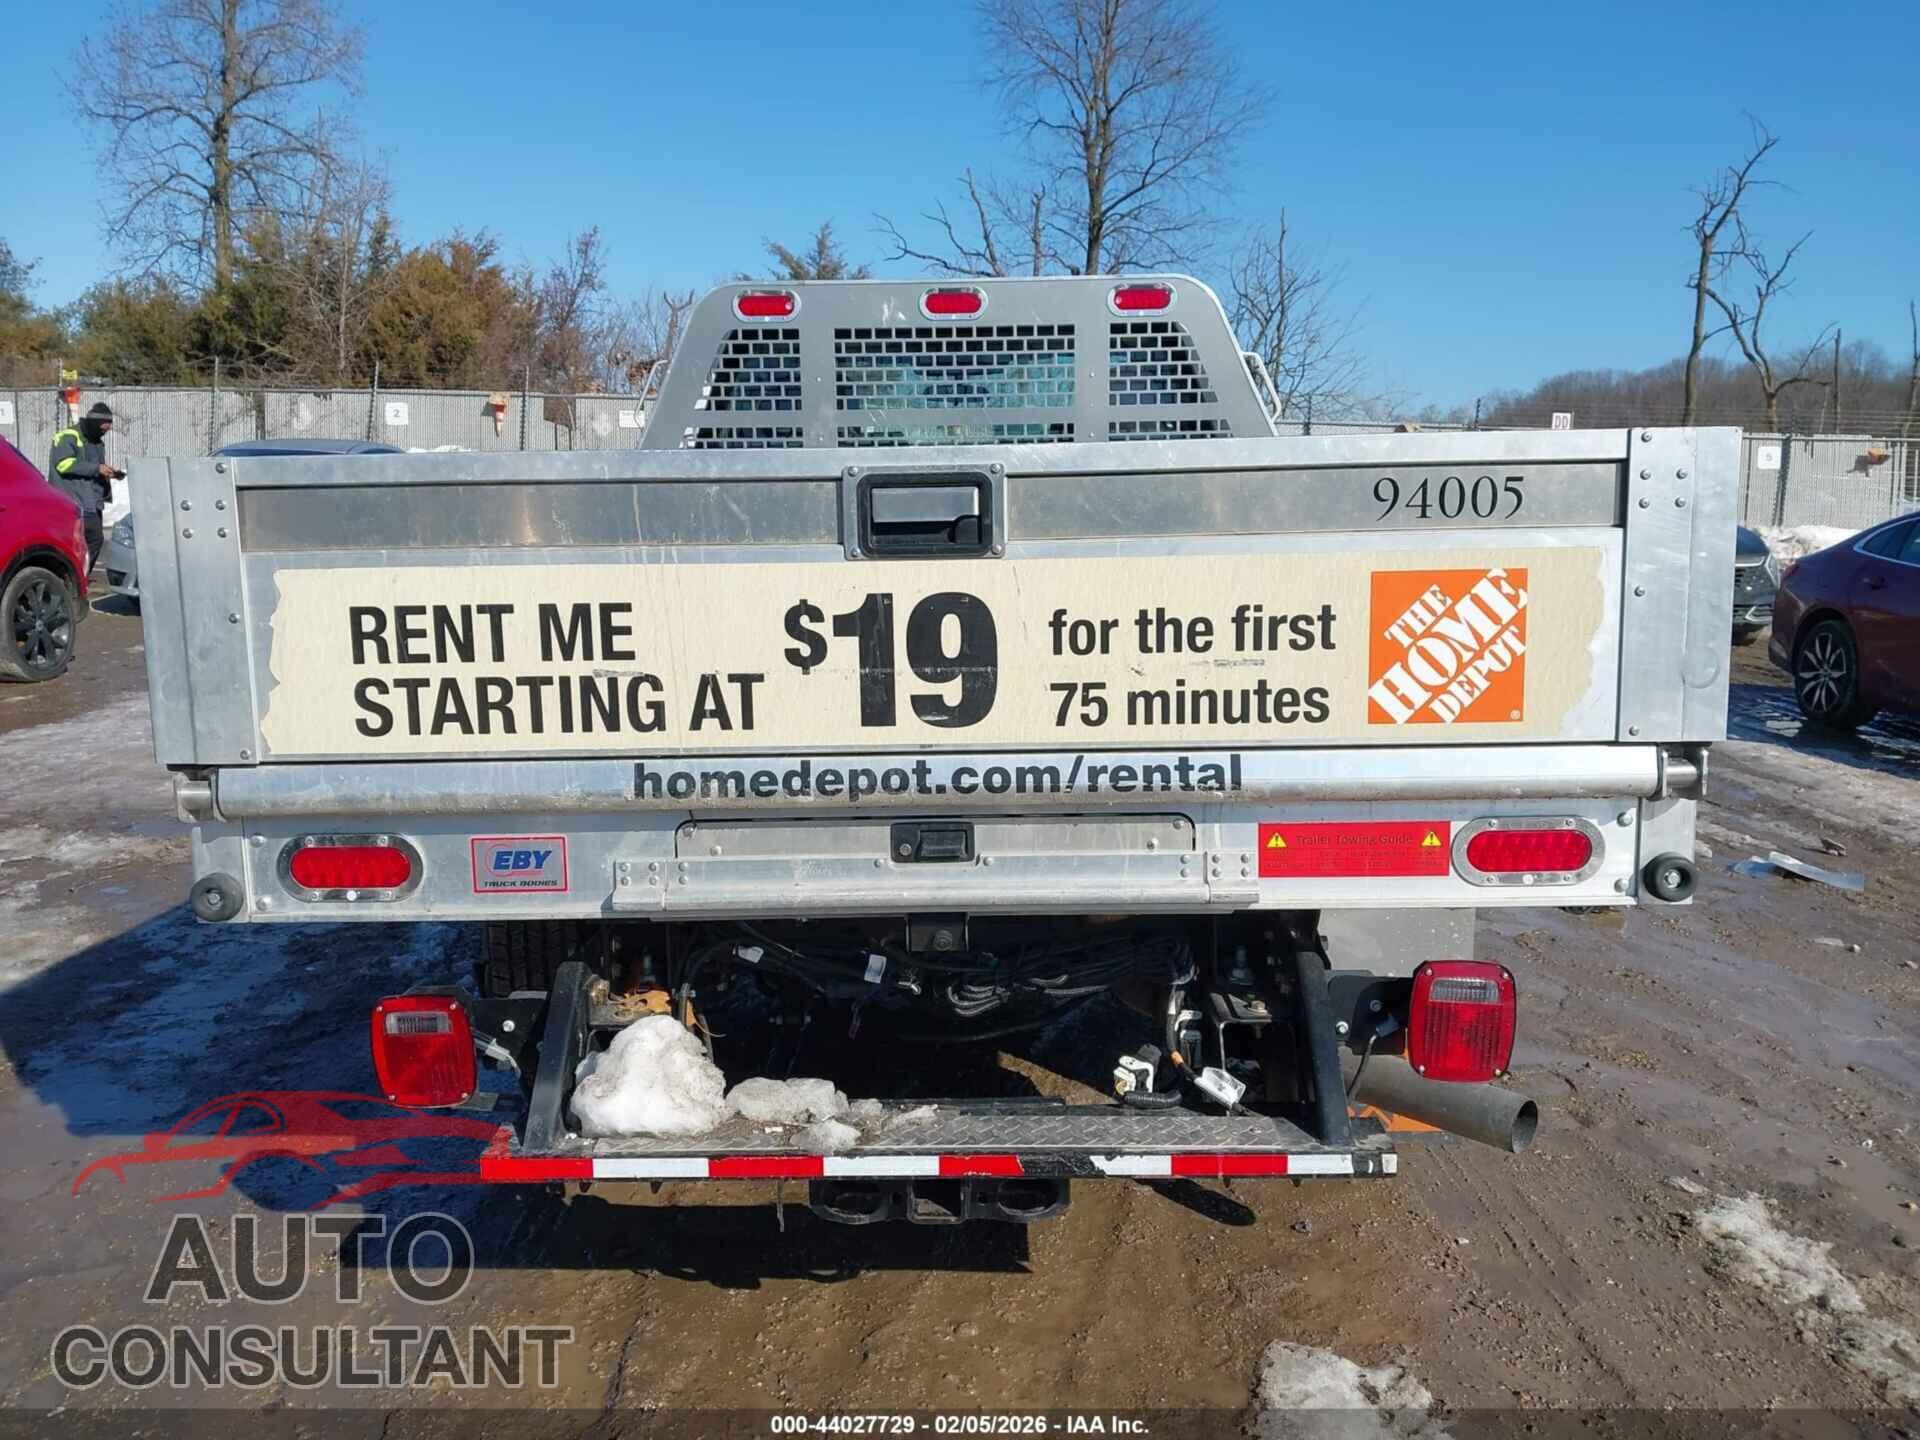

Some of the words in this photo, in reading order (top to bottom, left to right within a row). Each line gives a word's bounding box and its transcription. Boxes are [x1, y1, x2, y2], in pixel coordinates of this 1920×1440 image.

[392, 409, 400, 418] 2
[1373, 475, 1524, 521] 94005
[349, 604, 515, 664] RENT
[538, 602, 636, 661] ME
[1049, 609, 1119, 655] for
[1134, 607, 1214, 653] the
[1231, 604, 1337, 651] first
[1384, 584, 1453, 648] THE
[784, 591, 998, 728] $19
[1368, 568, 1528, 724] HOME
[1428, 625, 1527, 723] DEPOT
[354, 673, 667, 737] STARTING
[689, 672, 765, 731] AT
[1050, 682, 1108, 727] 75
[1127, 679, 1330, 726] minutes
[633, 753, 1242, 801] homedepot.com/rental
[493, 850, 552, 870] EBY
[1379, 832, 1413, 845] Guide
[484, 880, 517, 888] TRUCK
